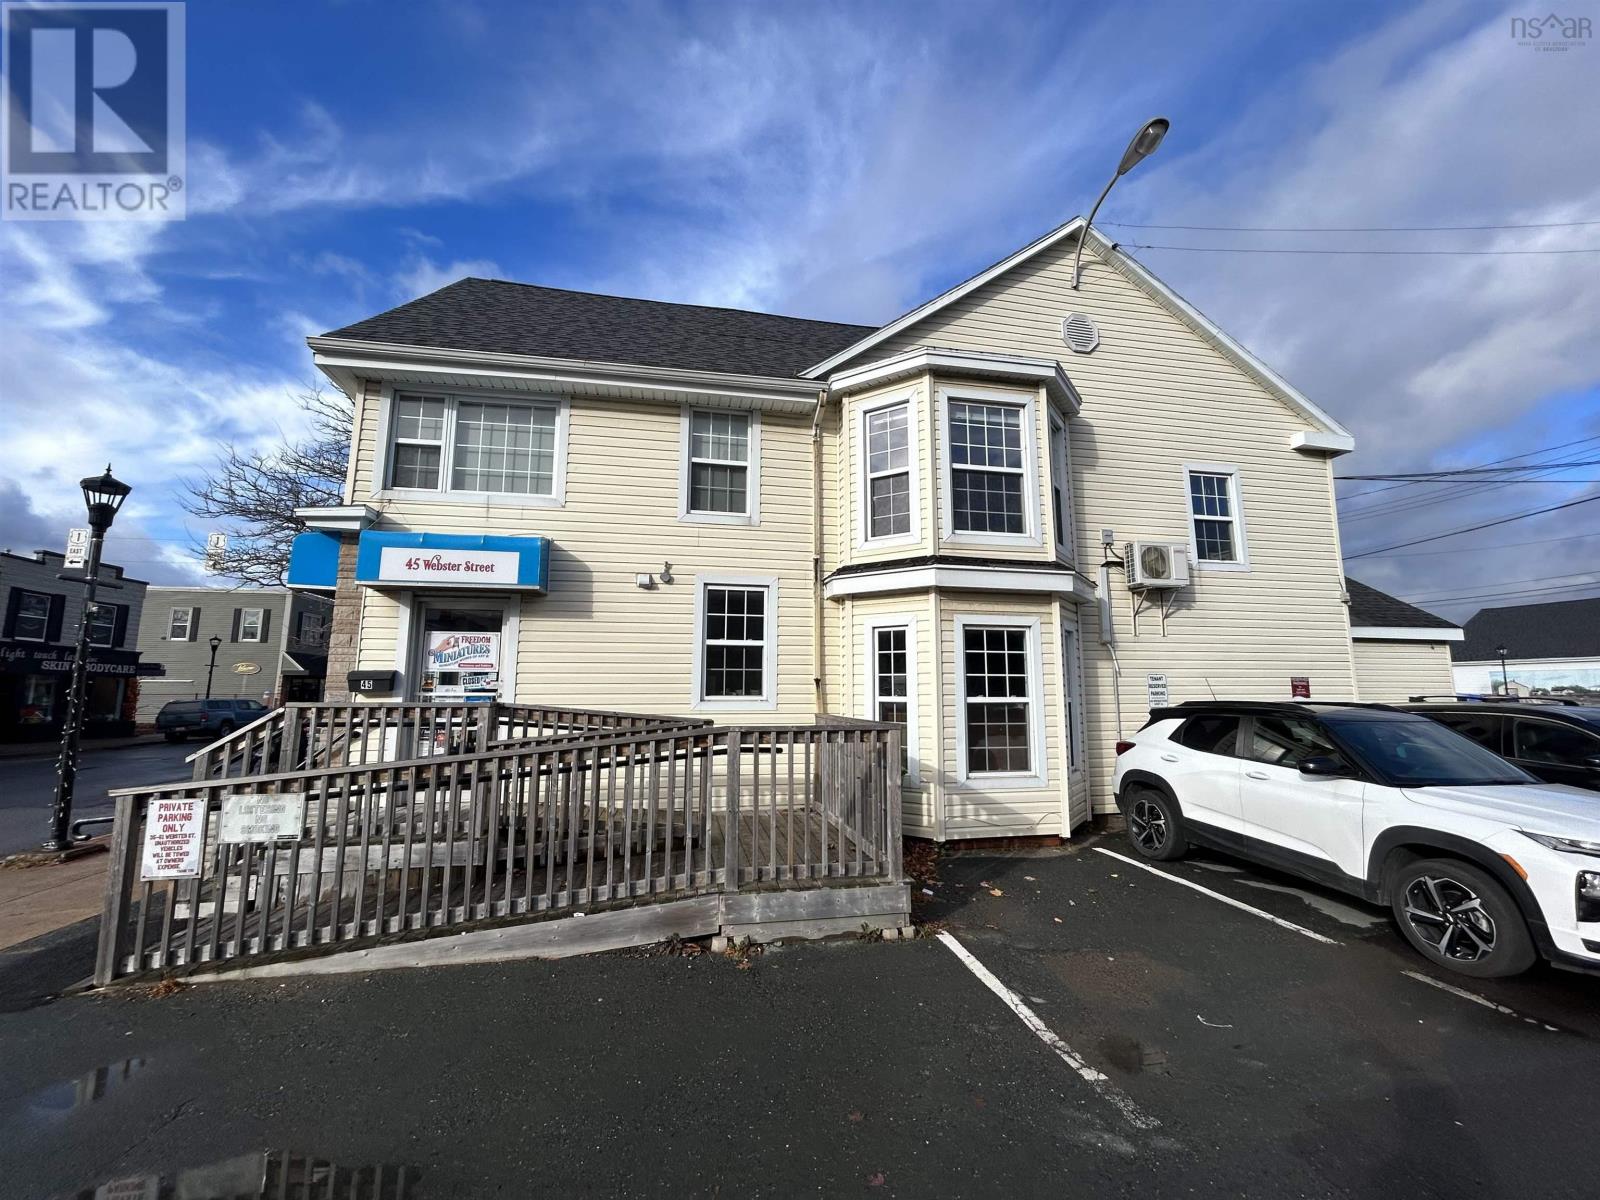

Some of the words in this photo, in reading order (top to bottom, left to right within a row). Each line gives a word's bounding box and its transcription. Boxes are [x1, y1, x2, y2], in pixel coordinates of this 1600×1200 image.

[405, 557, 421, 571] 45
[422, 554, 462, 572] Webster
[464, 560, 495, 573] Street
[461, 635, 491, 645] FREEDOM
[428, 644, 491, 664] MINIATURES
[41, 660, 71, 672] SKIN
[361, 680, 373, 690] 45
[462, 677, 480, 686] CLOSED
[158, 802, 194, 812] PRIVATE
[157, 813, 193, 822] PARKING
[162, 823, 185, 833] ONLY
